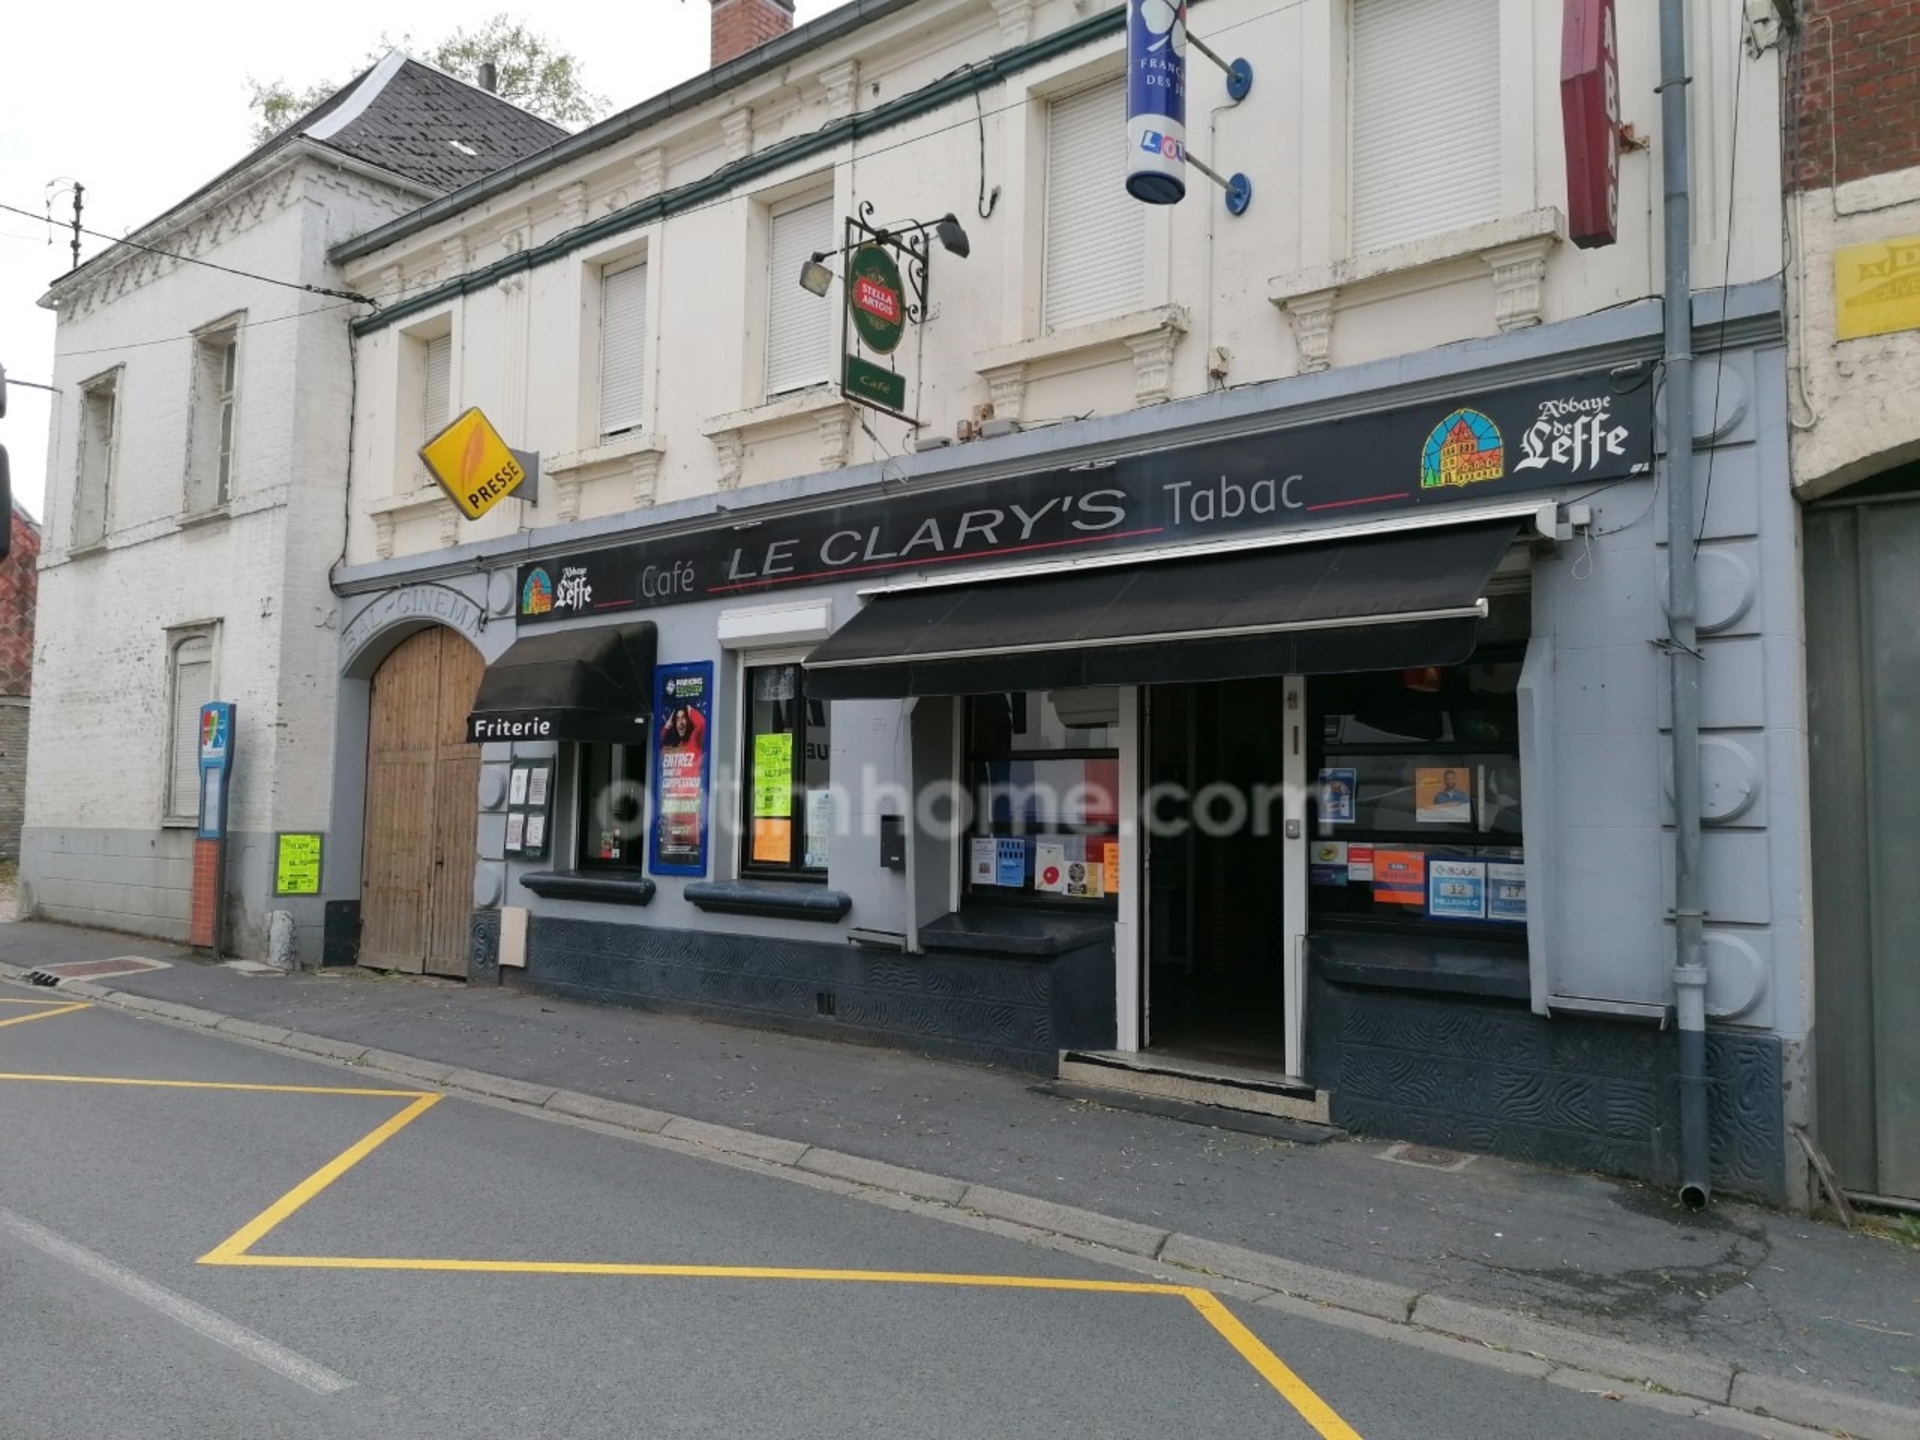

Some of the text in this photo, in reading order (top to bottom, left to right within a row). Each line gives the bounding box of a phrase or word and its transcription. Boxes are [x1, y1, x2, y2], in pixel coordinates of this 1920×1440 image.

[1146, 74, 1171, 89] DES
[861, 283, 893, 306] STELLA
[861, 294, 893, 316] ARTOIS
[860, 374, 891, 394] Café
[1537, 396, 1611, 421] Abbaye
[1553, 420, 1573, 437] de
[1513, 412, 1629, 473] Leffe
[467, 461, 519, 510] PRESSE
[641, 474, 1304, 598] Café LE CLARY'S Tabac
[554, 577, 593, 611] Leffe
[474, 717, 551, 738] Friterie
[662, 752, 695, 768] ENTREZ
[1449, 884, 1465, 895] 12
[1505, 886, 1521, 898] 17
